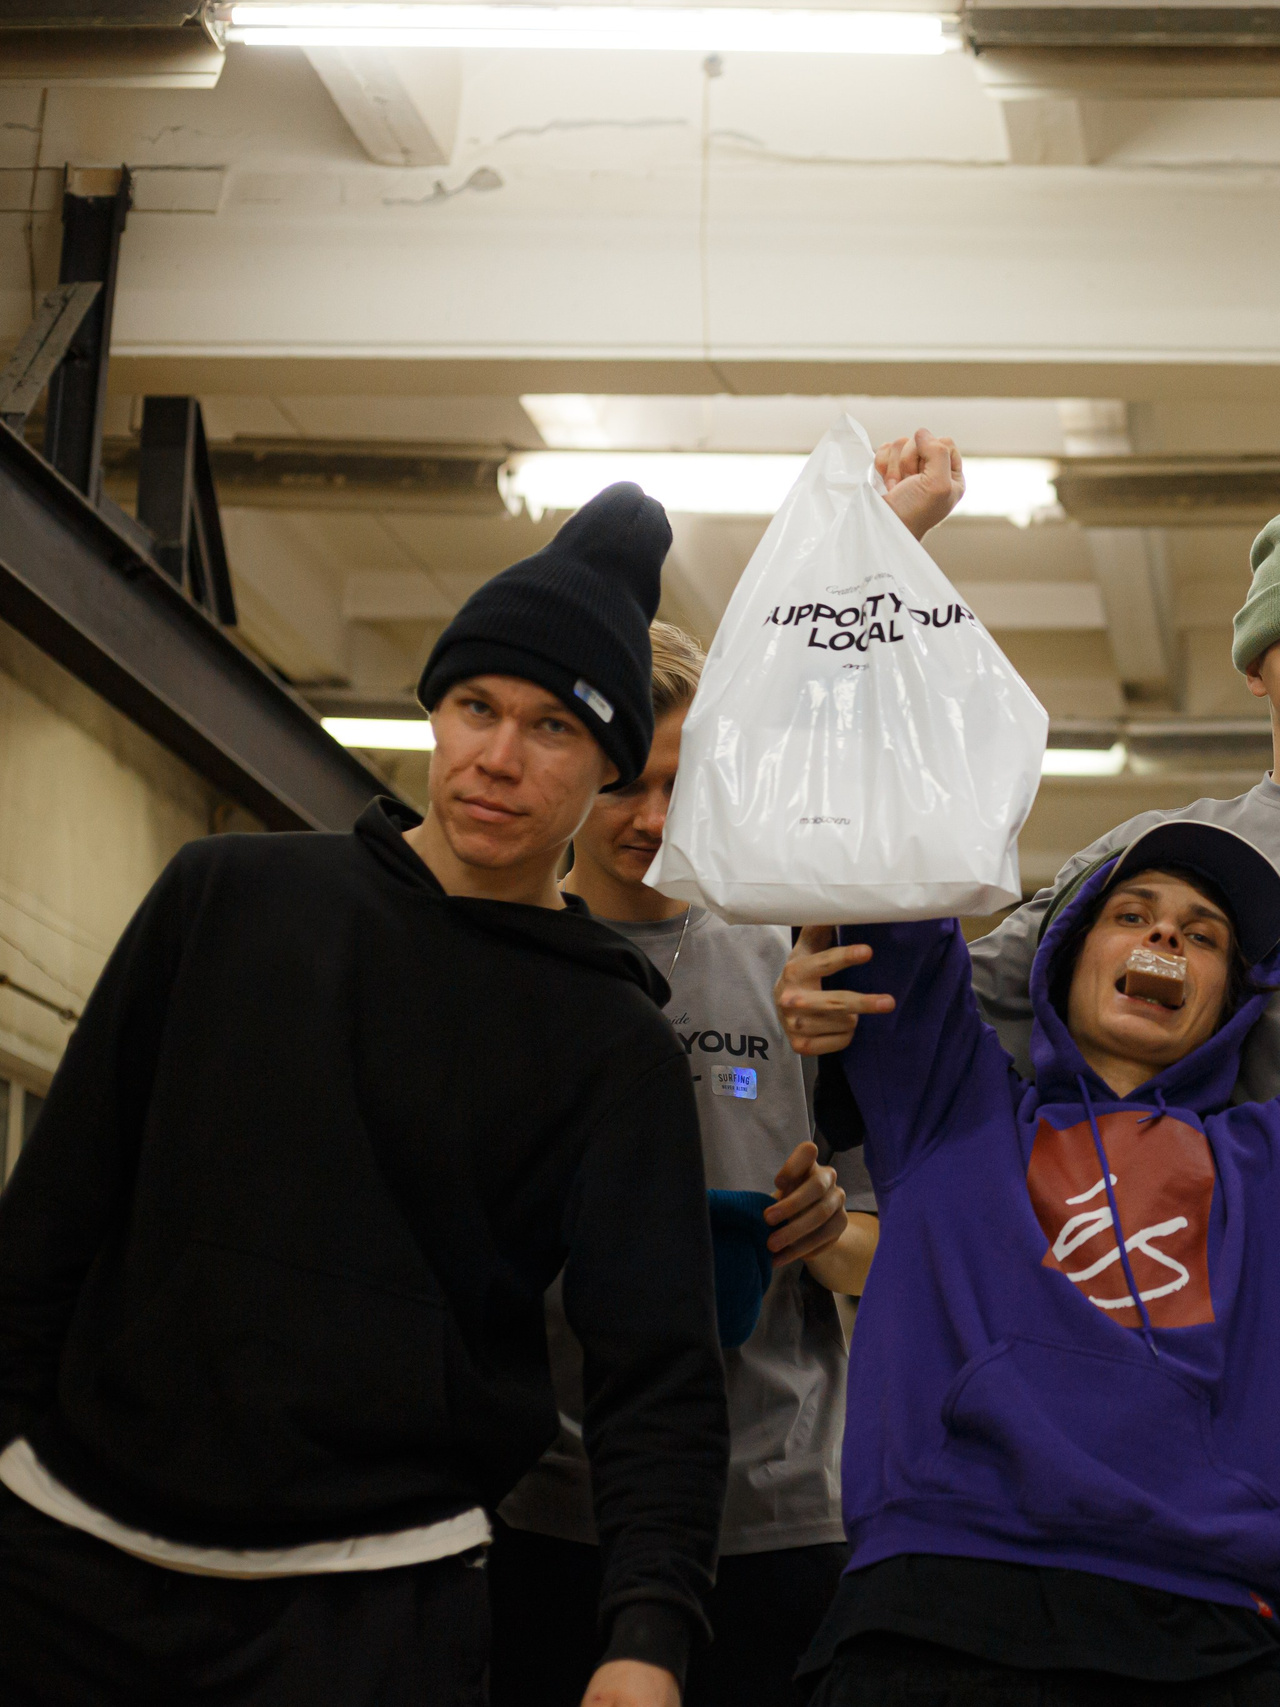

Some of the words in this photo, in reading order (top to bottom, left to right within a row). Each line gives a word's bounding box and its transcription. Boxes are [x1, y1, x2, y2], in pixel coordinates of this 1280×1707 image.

[762, 594, 885, 627] UPPOT
[671, 1012, 690, 1025] ide
[677, 1030, 770, 1061] YOUR
[718, 1073, 750, 1085] SURFING
